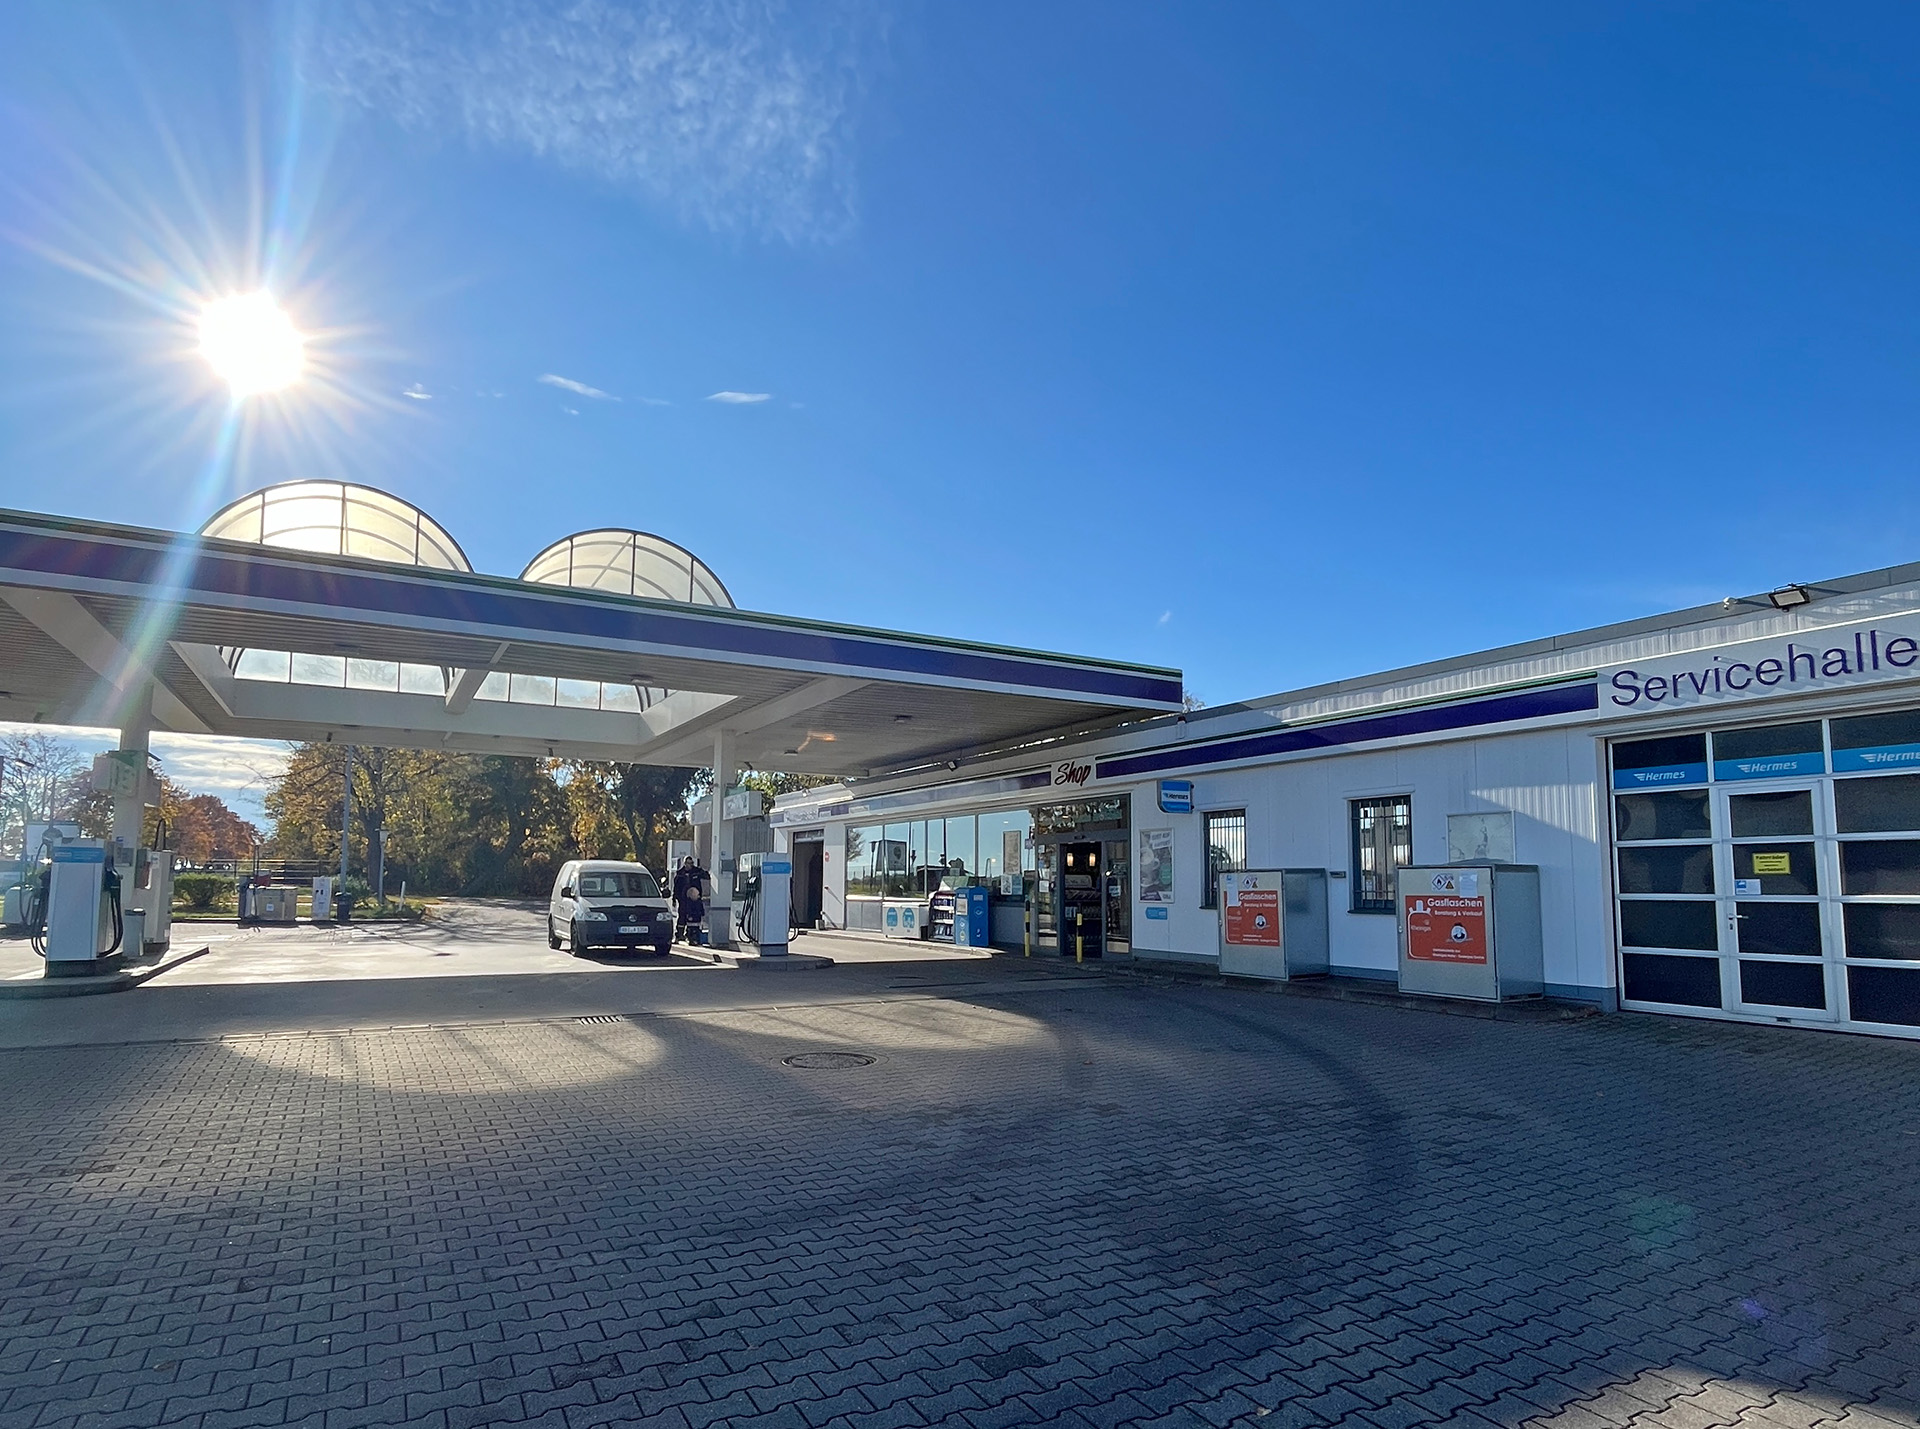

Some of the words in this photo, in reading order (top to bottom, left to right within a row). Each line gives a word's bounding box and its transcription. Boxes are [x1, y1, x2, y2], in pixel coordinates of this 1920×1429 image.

[1610, 630, 1919, 706] Servicehalle
[1750, 760, 1797, 773] Hermes
[1054, 761, 1092, 786] Shop
[1645, 770, 1685, 781] Hermes
[1427, 898, 1483, 907] Gasflaschen
